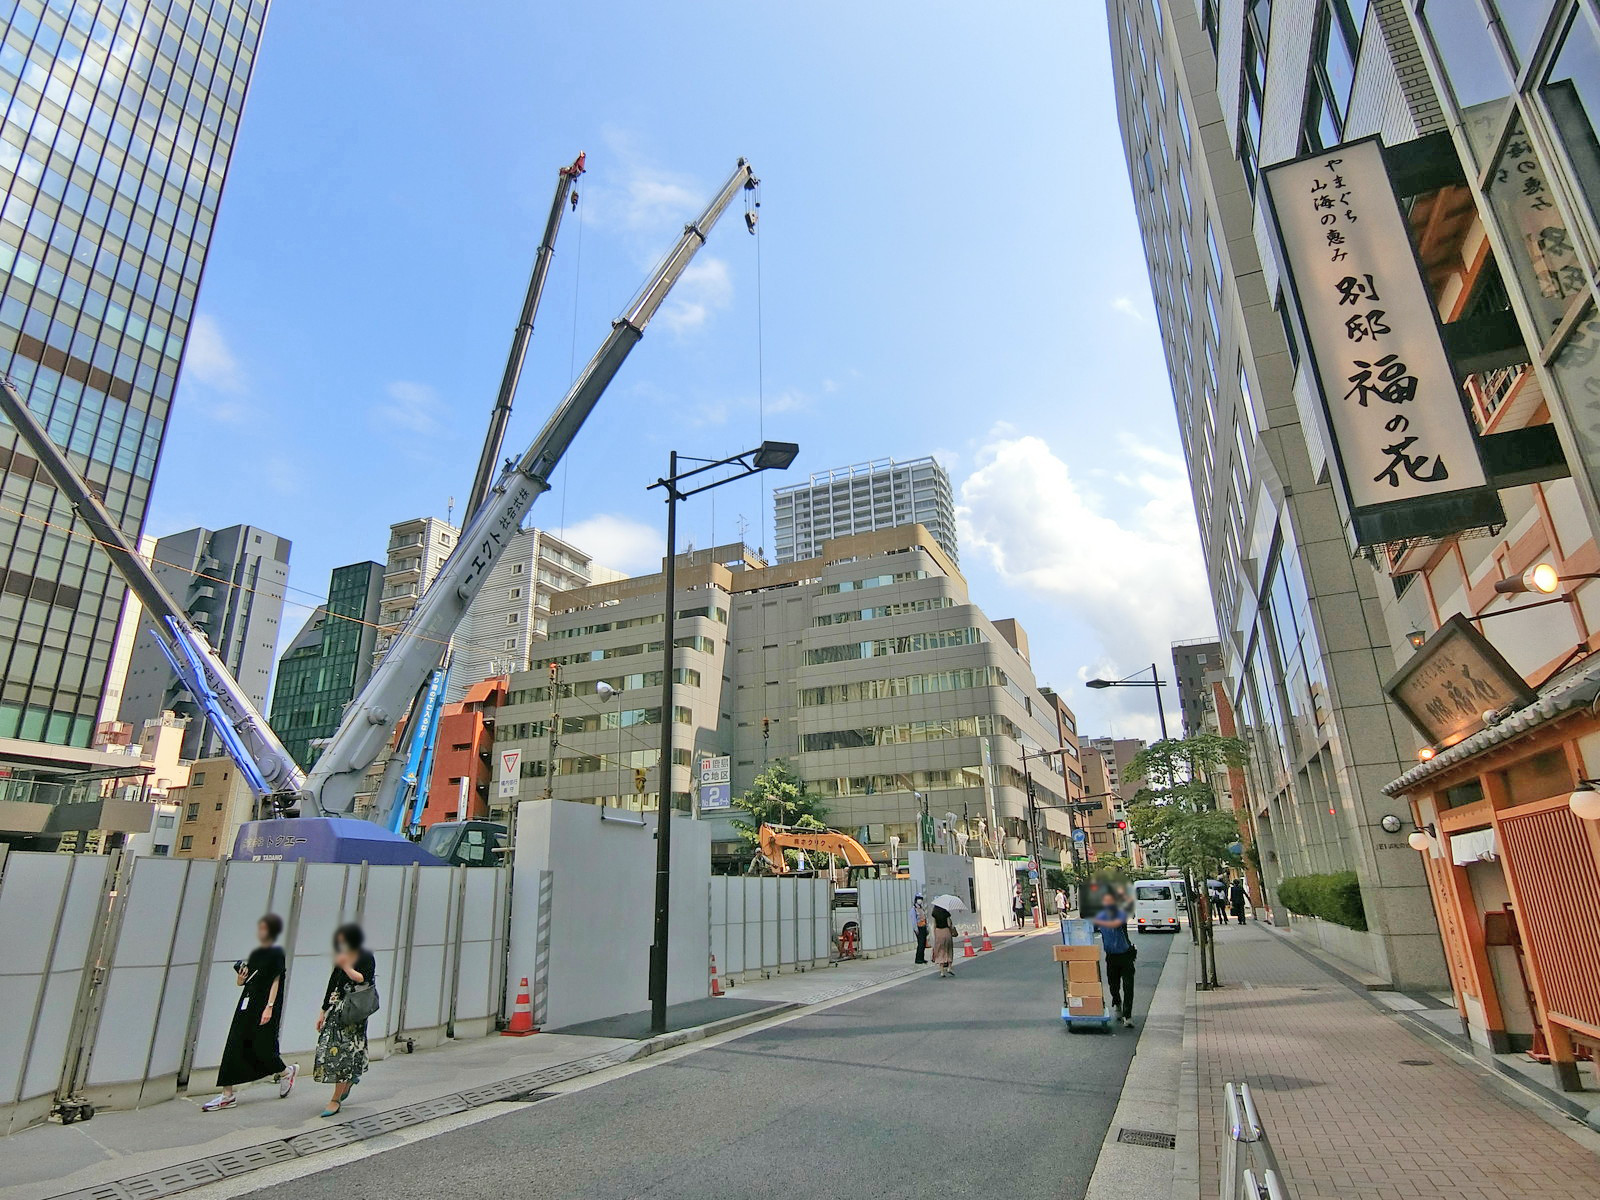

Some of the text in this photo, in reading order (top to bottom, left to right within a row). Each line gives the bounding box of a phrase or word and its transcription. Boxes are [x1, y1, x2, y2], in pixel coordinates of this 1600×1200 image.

[1311, 179, 1348, 262] 山海の恵み
[1324, 158, 1357, 224] やまぐち
[1334, 273, 1449, 487] 別邸 福の花
[499, 487, 530, 531] 株式会社
[267, 835, 308, 848] トクエー
